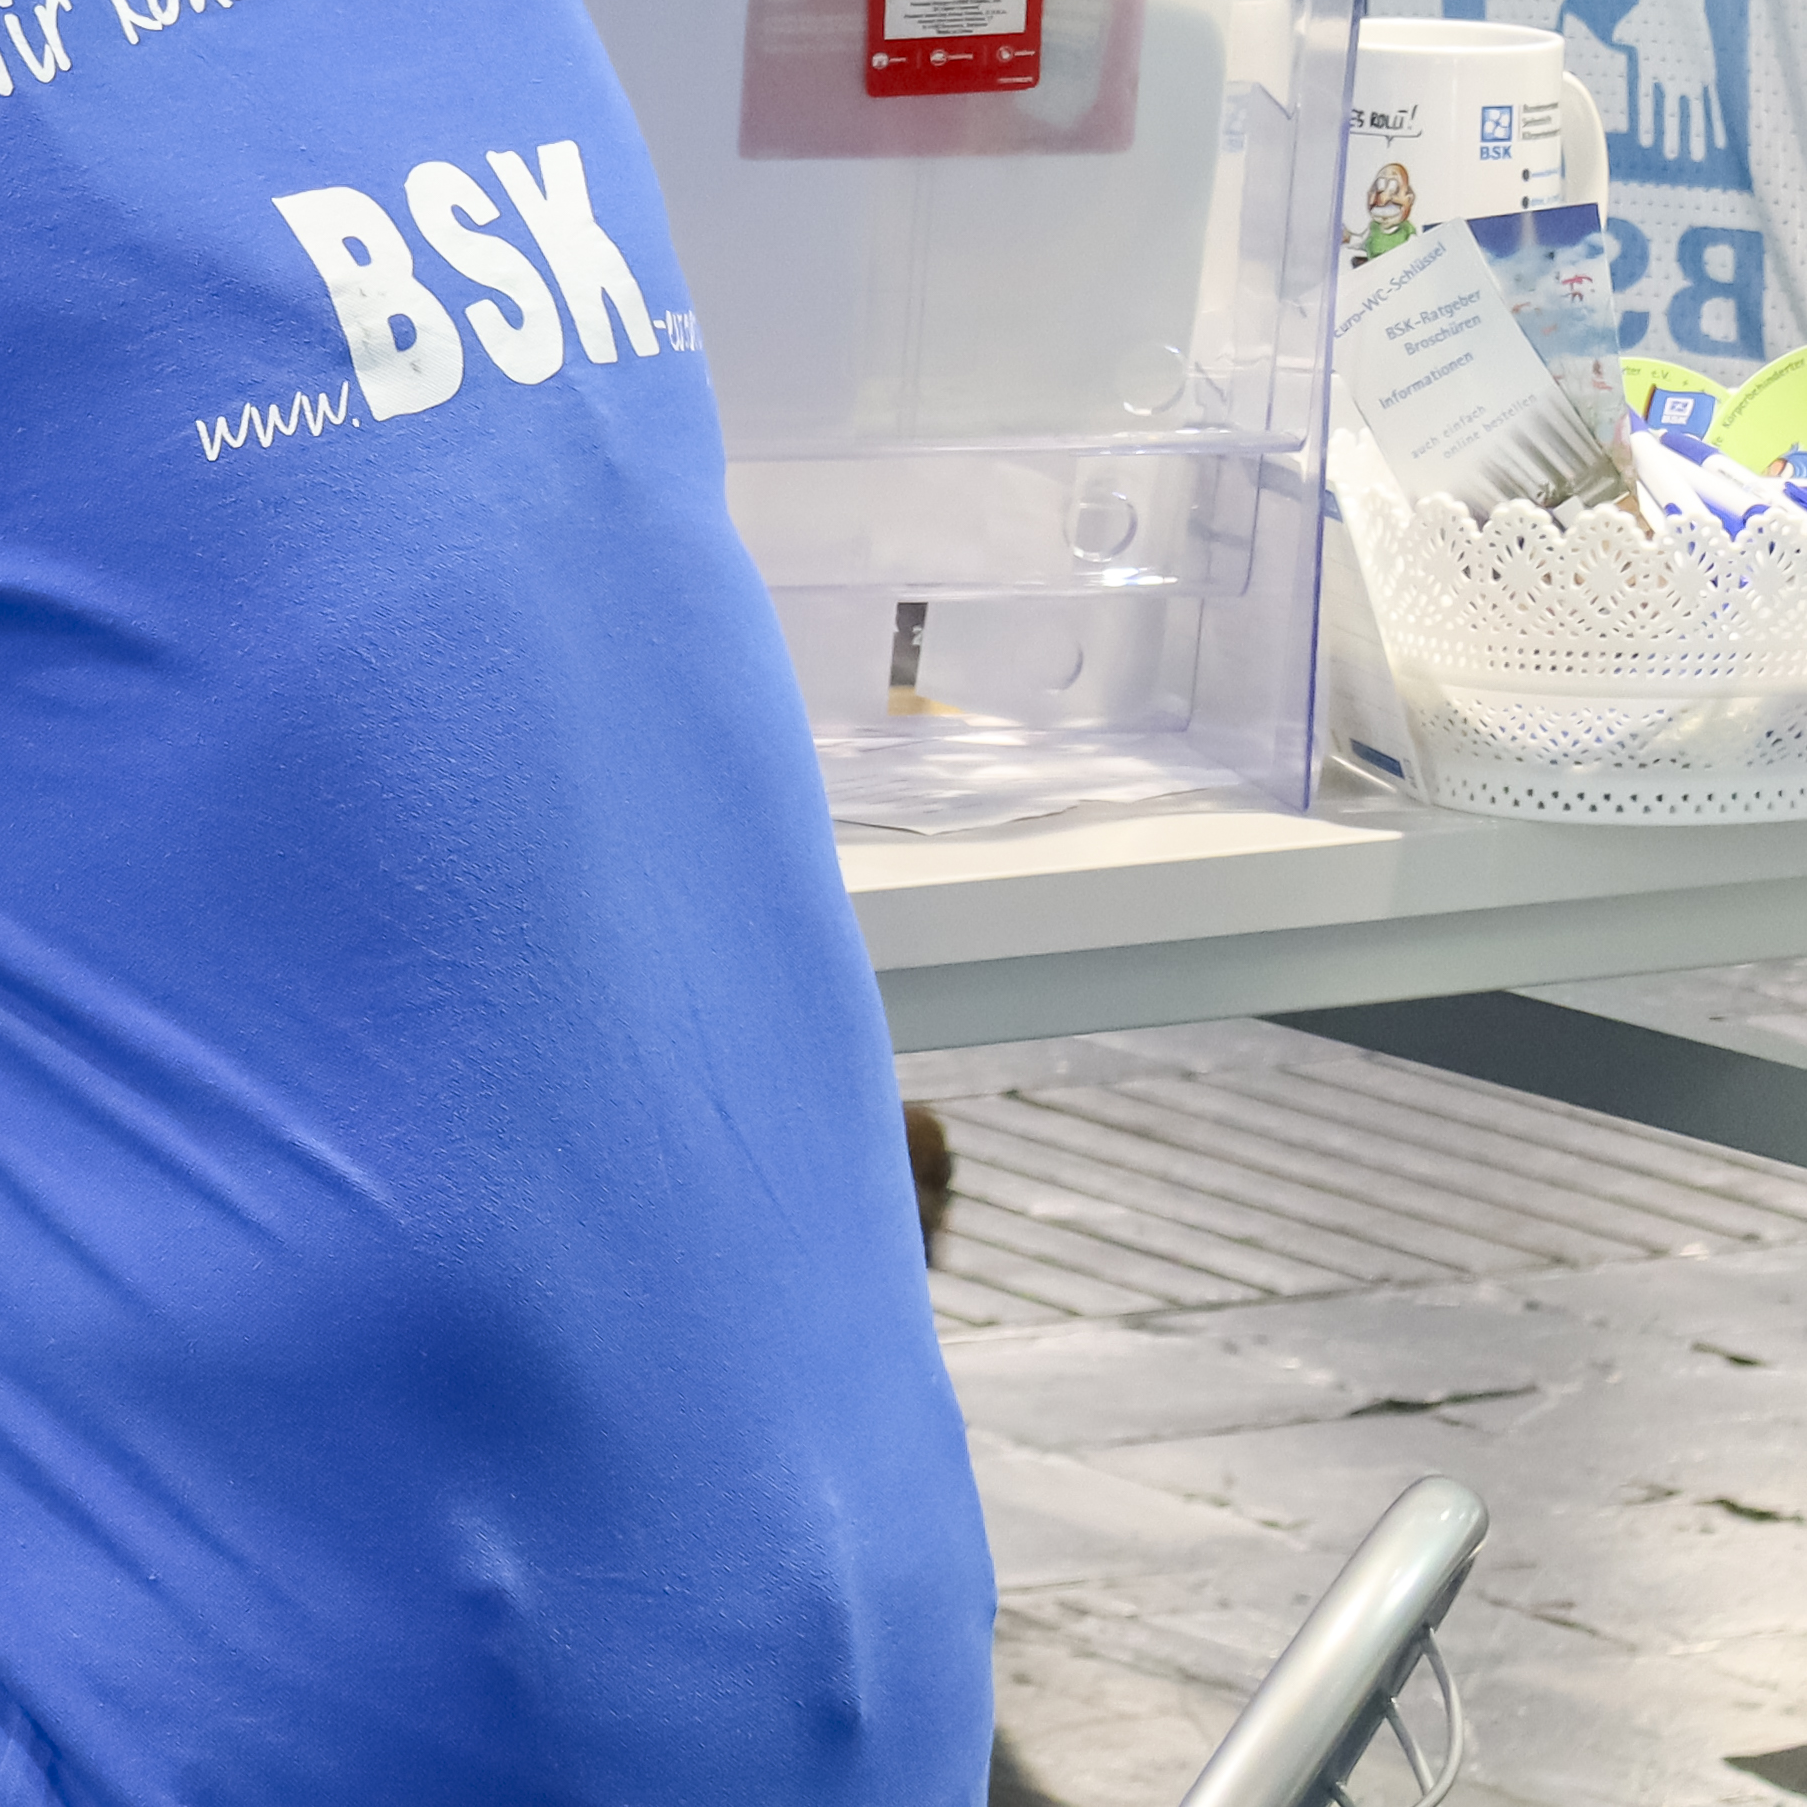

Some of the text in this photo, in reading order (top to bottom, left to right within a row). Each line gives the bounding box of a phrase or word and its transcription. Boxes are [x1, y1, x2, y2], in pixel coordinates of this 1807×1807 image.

[1479, 146, 1513, 161] BSK
[1385, 288, 1482, 340] BSK-Ratgeber
[1405, 314, 1482, 356] Broschüren
[1378, 351, 1474, 409] Informationen
